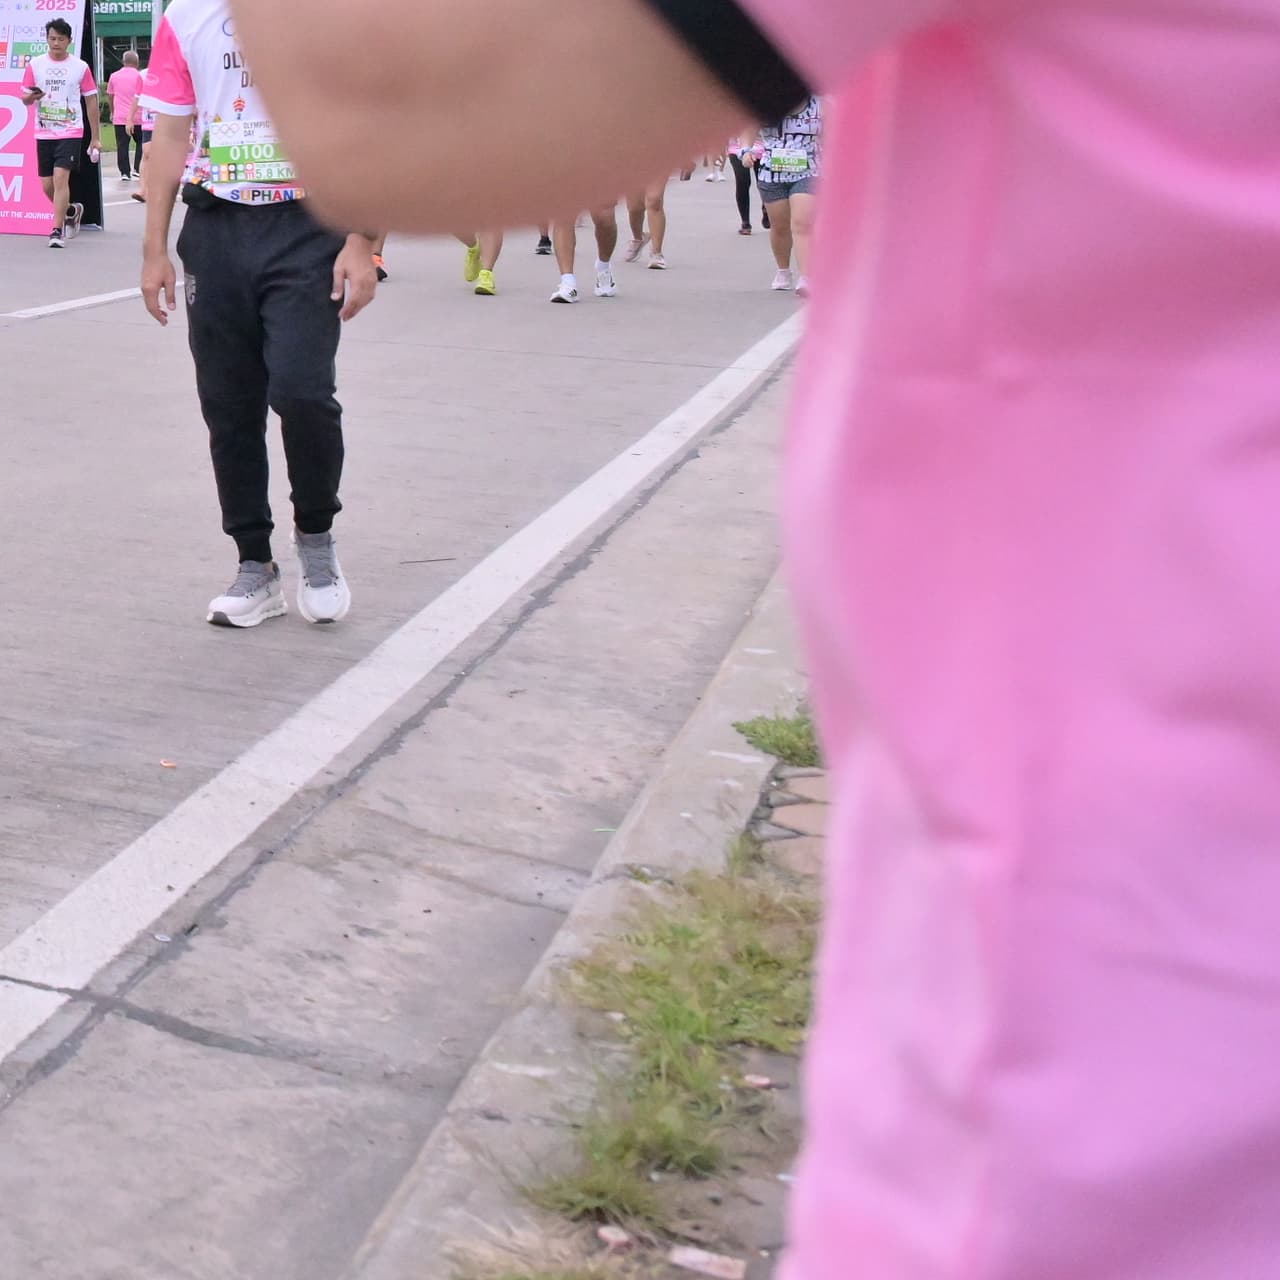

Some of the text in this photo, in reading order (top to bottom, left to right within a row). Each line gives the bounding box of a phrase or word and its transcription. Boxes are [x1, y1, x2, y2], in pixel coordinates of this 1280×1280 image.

[35, 0, 77, 10] 2025
[229, 144, 274, 160] 0100
[255, 168, 273, 178] 5.8
